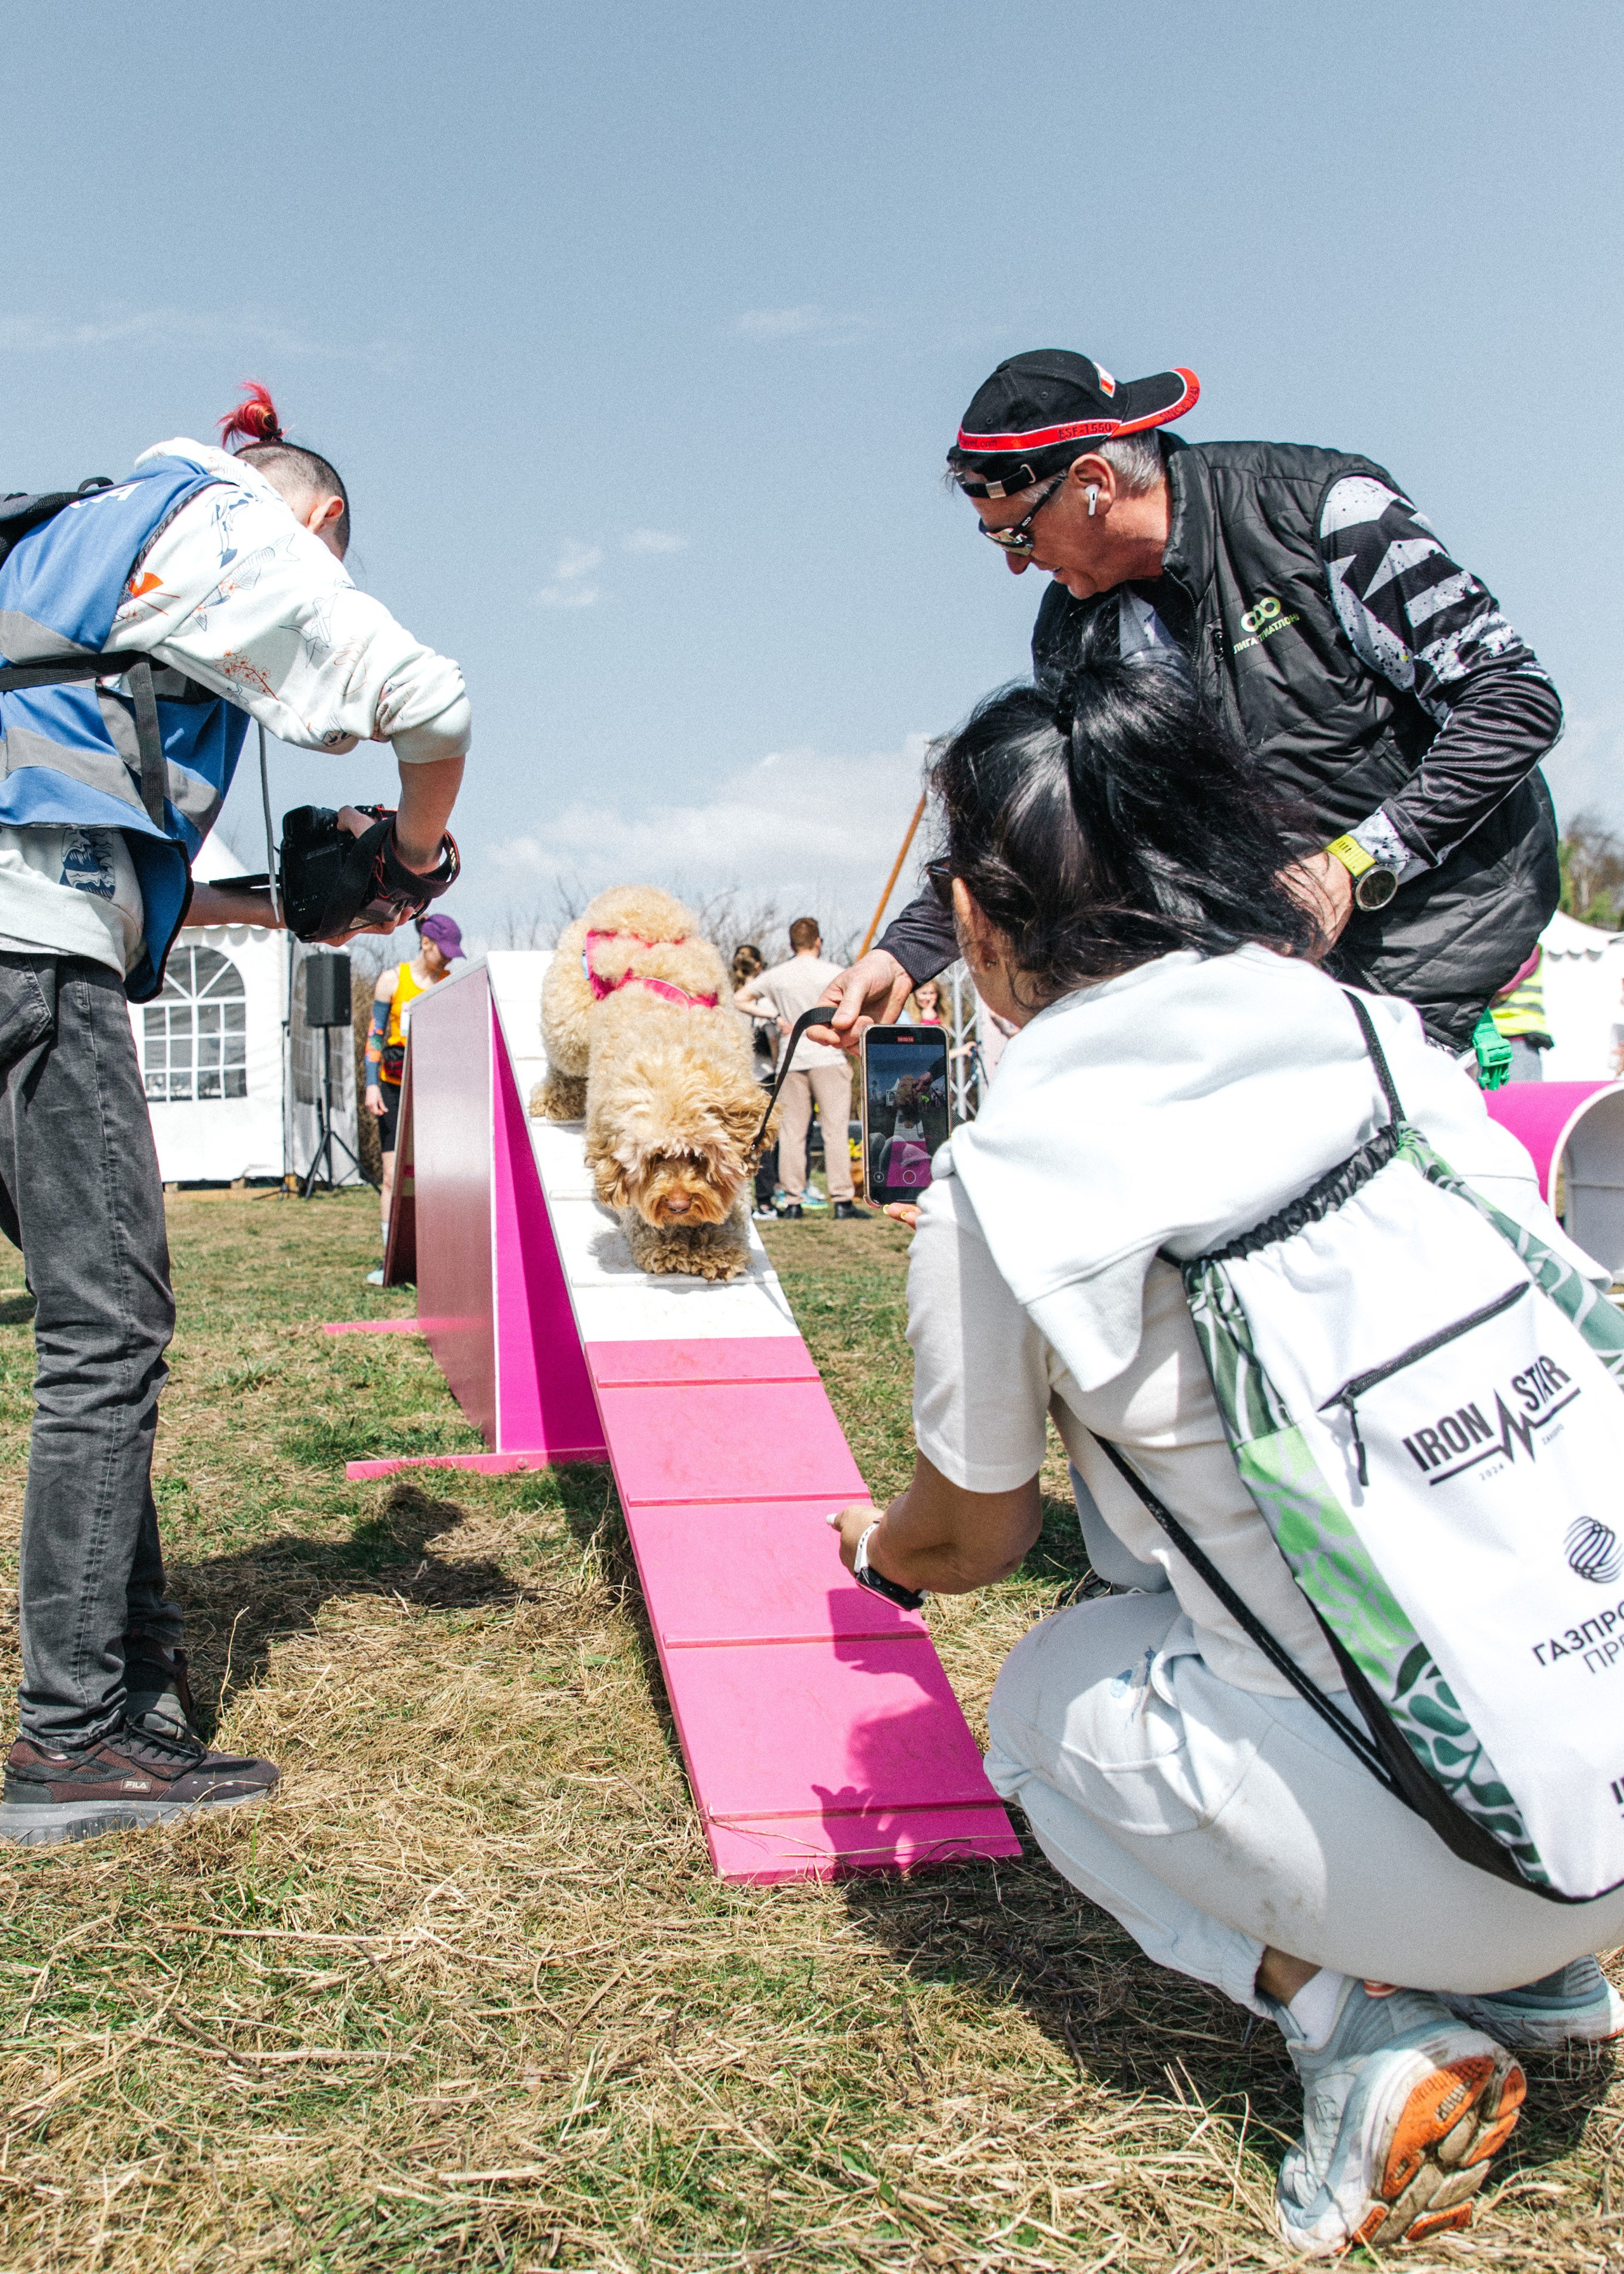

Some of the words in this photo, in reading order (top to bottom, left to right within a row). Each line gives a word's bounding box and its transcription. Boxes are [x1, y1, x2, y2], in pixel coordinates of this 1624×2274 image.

[1058, 423, 1113, 439] ESF-1550
[1233, 636, 1259, 654] ЛИГА
[1402, 1402, 1495, 1472] IRON
[1510, 1354, 1572, 1412] STAR
[126, 1780, 147, 1789] FILA
